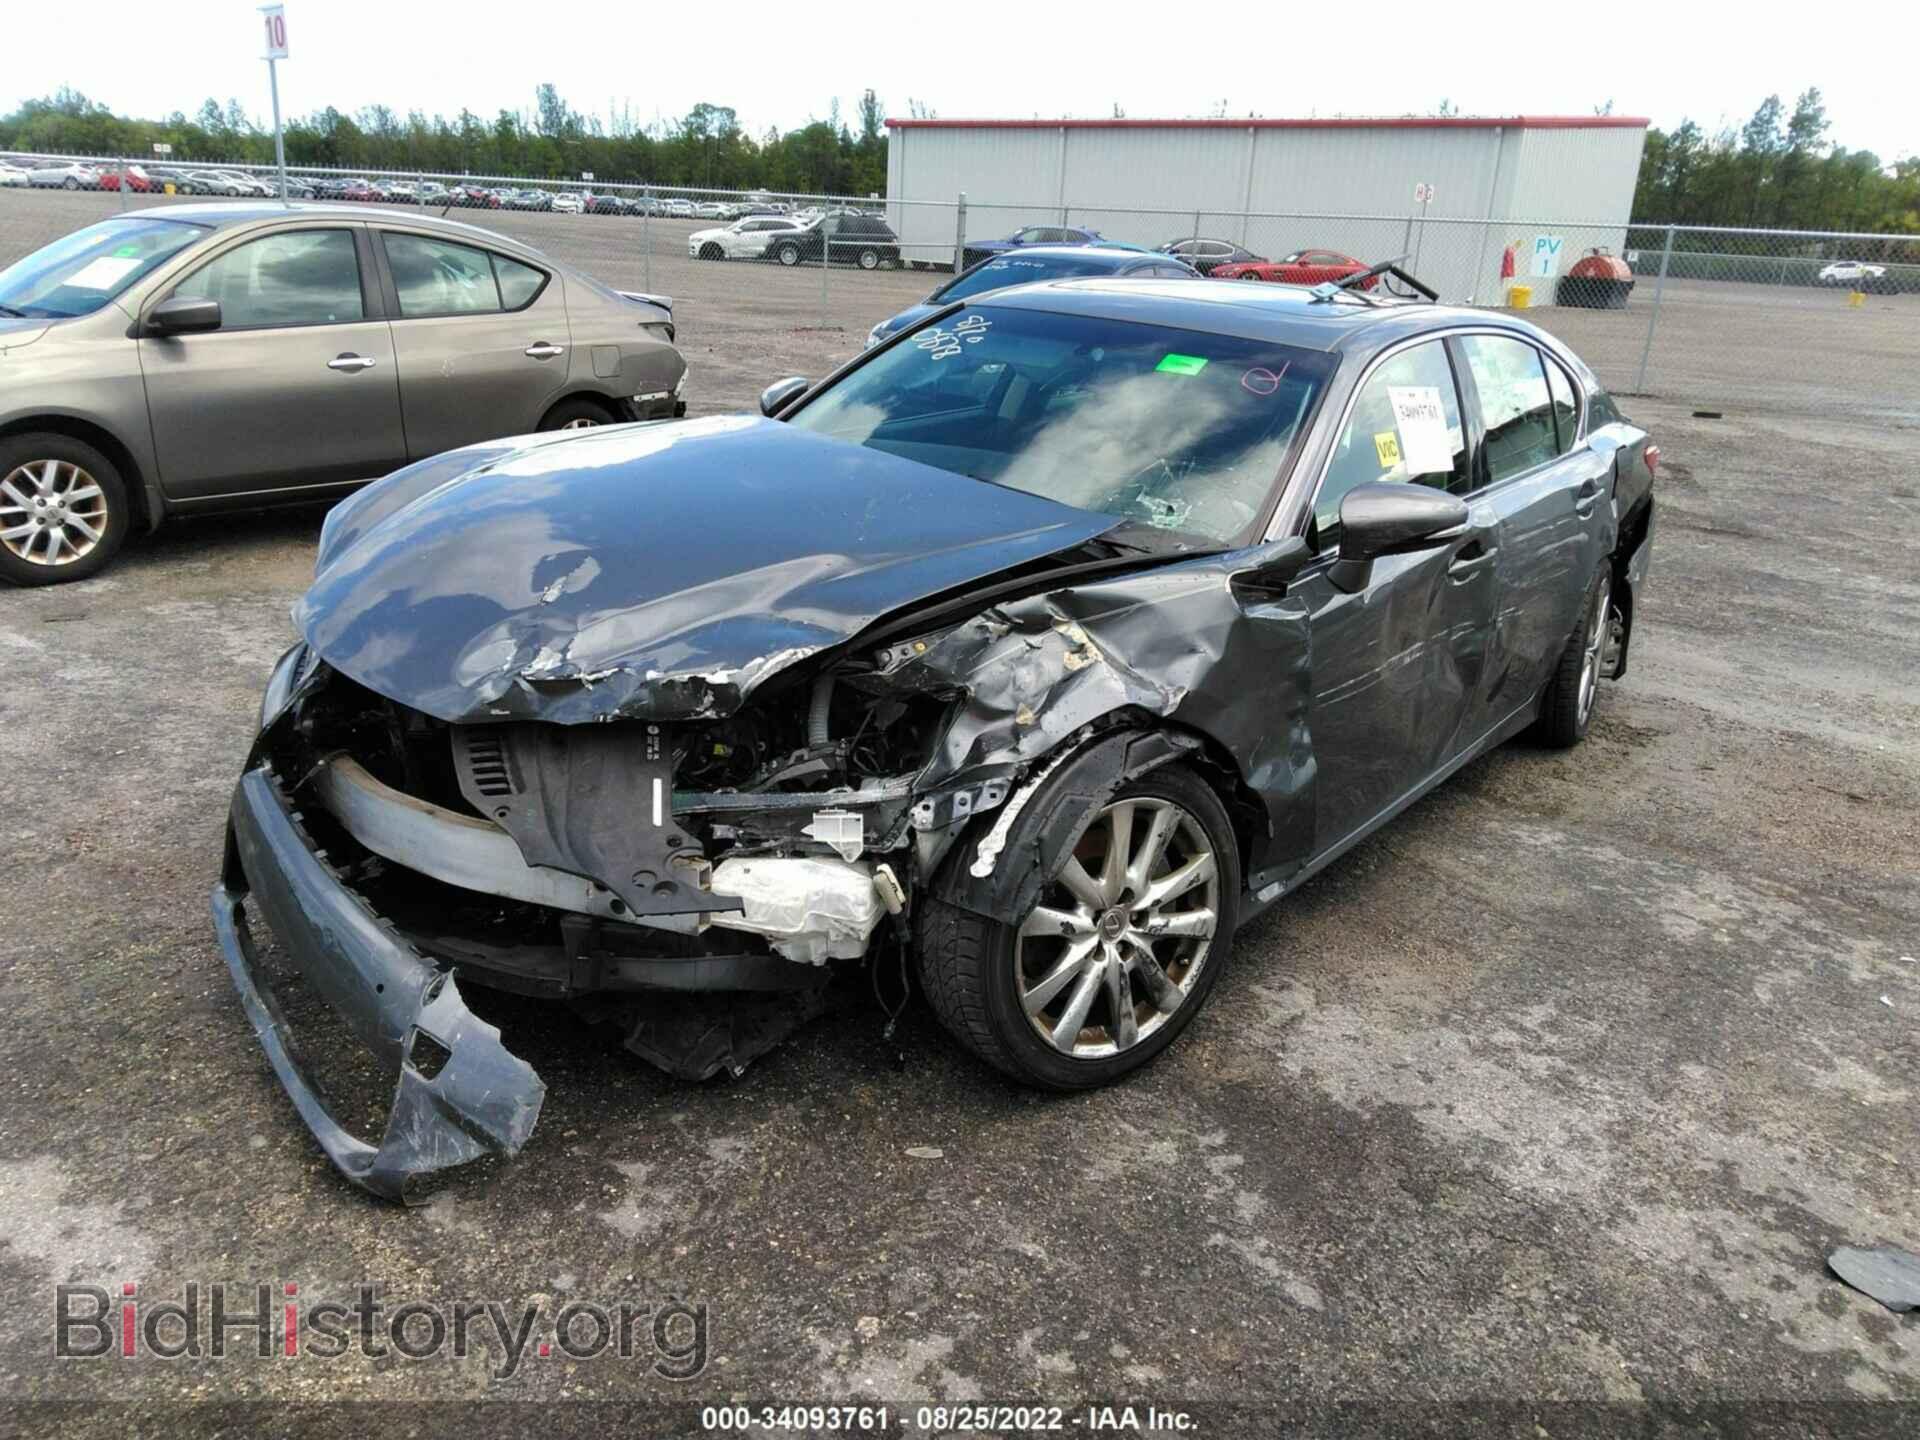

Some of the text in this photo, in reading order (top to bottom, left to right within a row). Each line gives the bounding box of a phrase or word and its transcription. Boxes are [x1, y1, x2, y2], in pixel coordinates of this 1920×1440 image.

[265, 15, 284, 48] 10
[1536, 239, 1561, 254] PV
[1377, 440, 1398, 458] VIC
